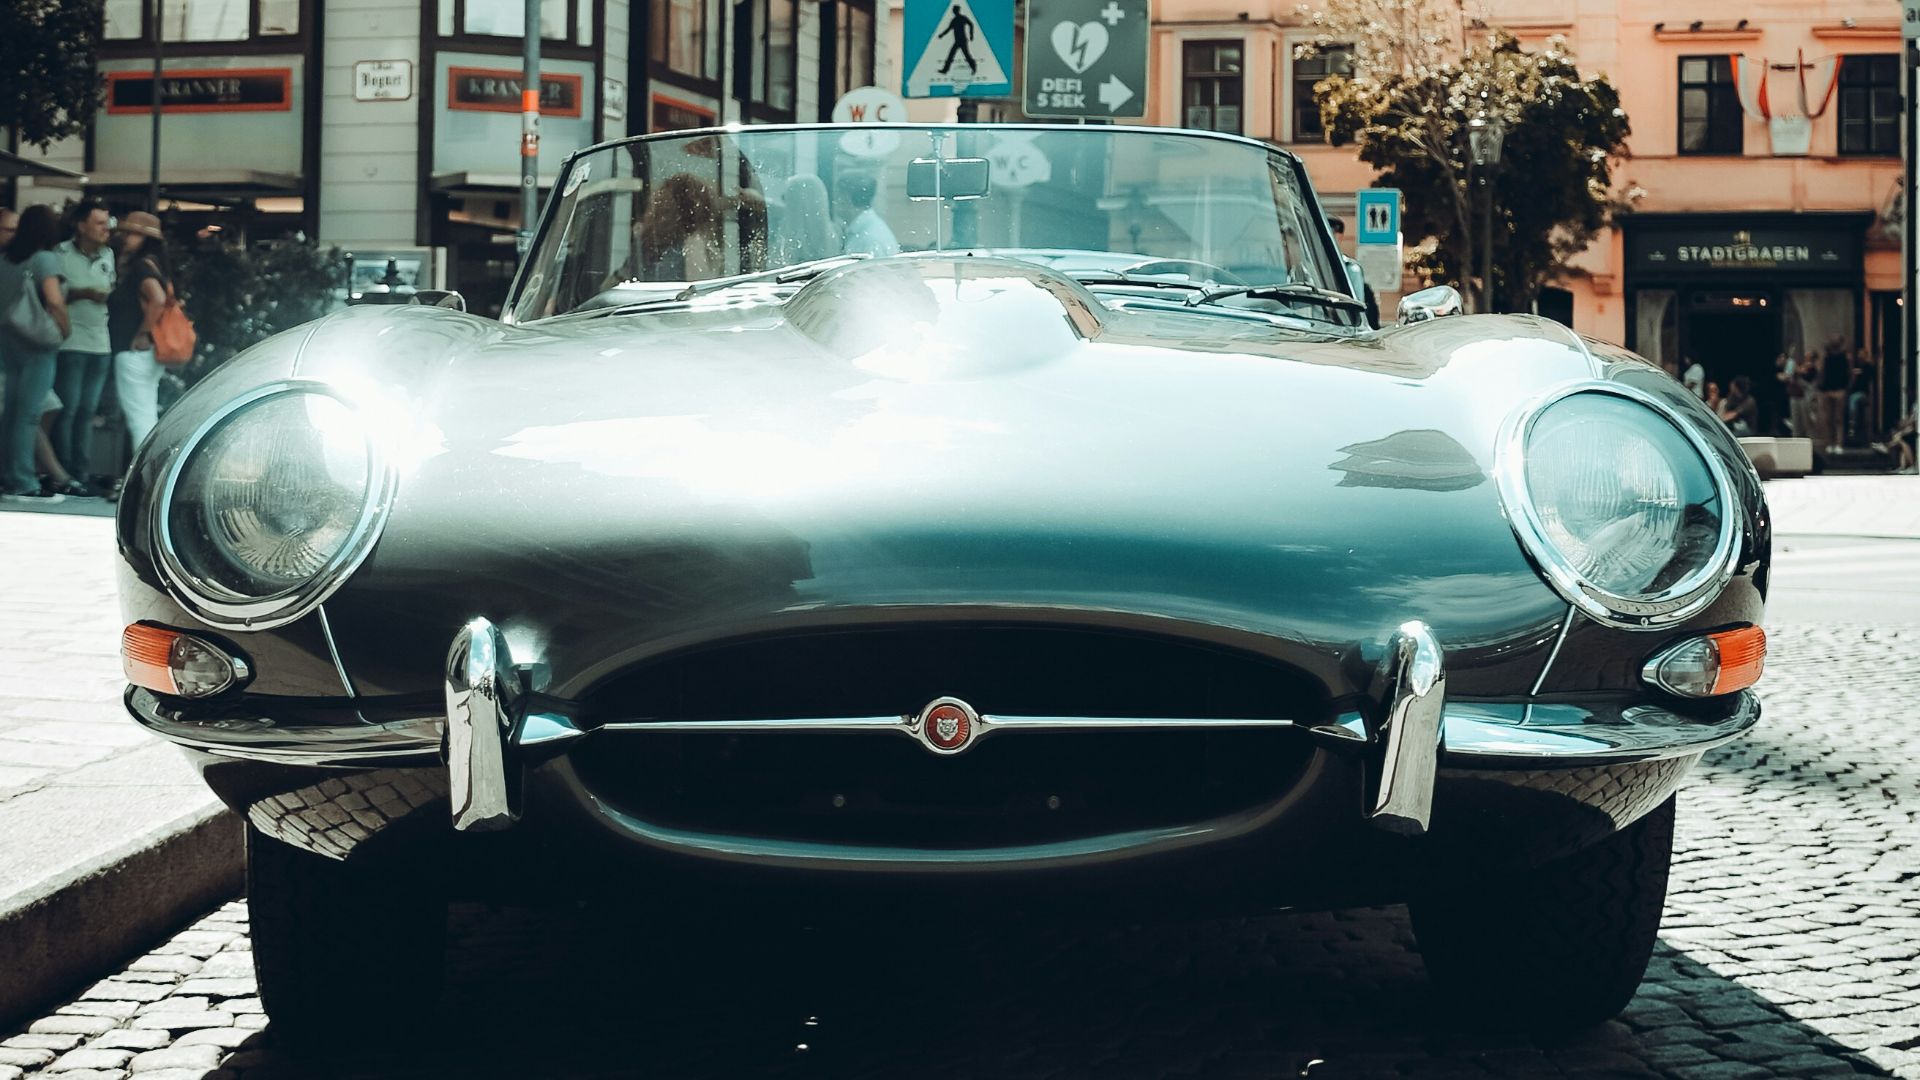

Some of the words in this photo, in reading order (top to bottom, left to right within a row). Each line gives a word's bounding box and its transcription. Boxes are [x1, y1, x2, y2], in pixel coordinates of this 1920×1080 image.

[1042, 78, 1082, 93] DEFI
[1037, 93, 1048, 107] 5
[1051, 93, 1086, 108] SEK
[1678, 246, 1809, 261] STADTGRABEN
